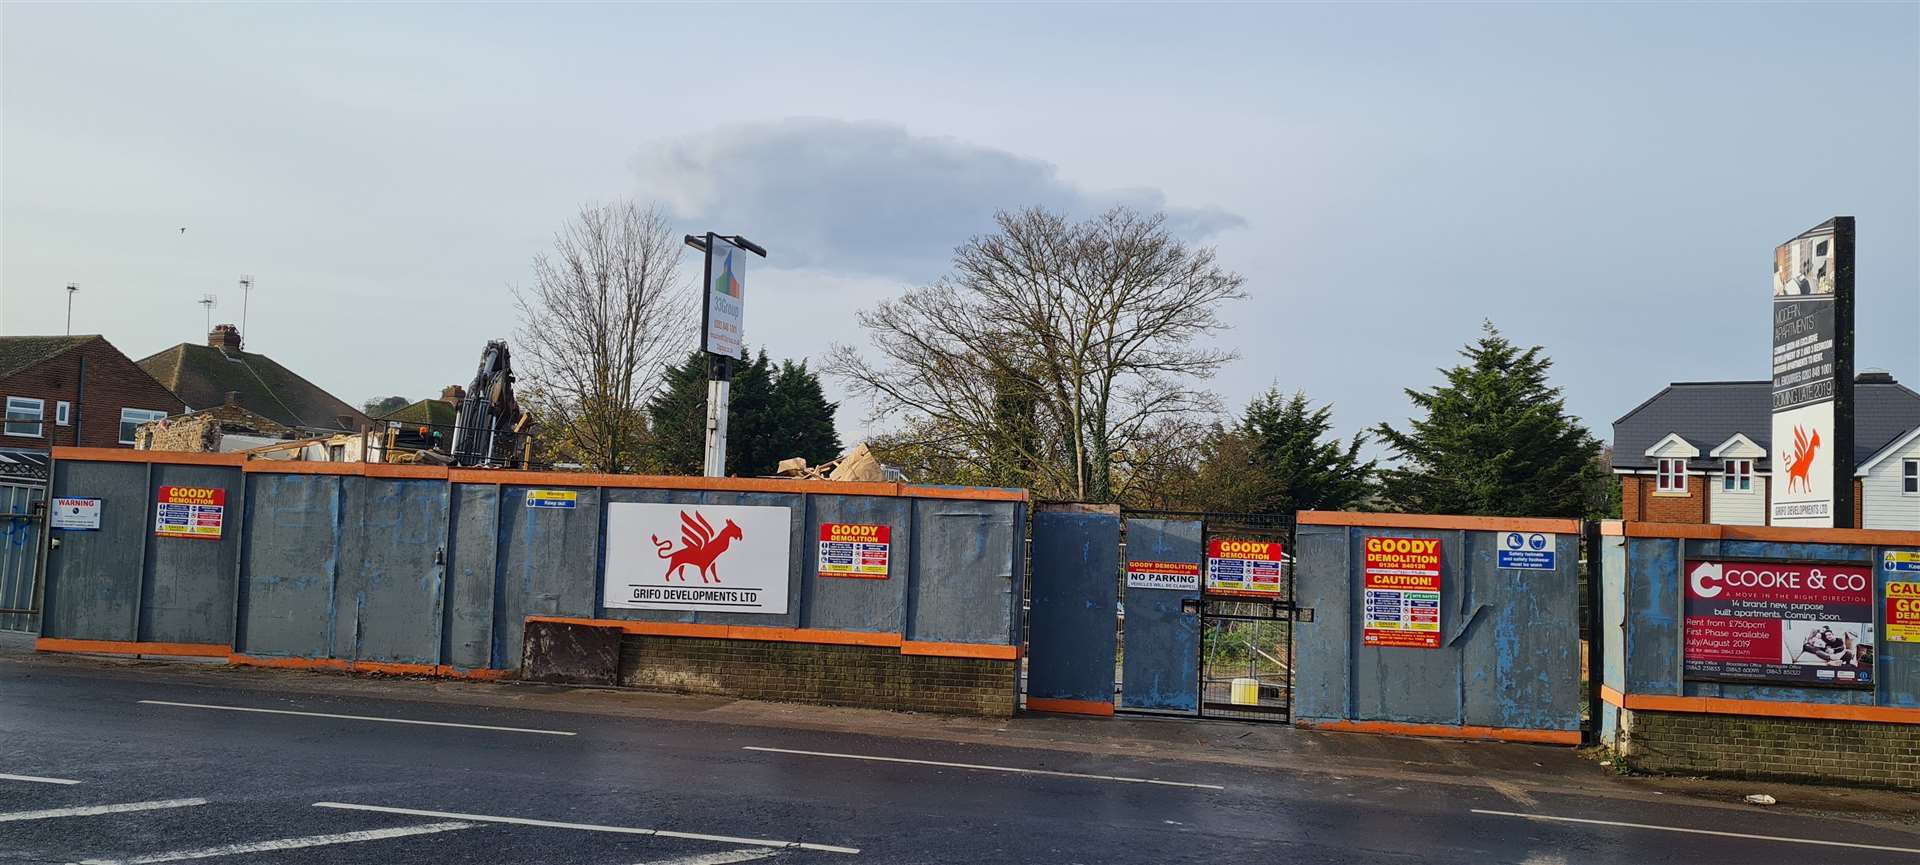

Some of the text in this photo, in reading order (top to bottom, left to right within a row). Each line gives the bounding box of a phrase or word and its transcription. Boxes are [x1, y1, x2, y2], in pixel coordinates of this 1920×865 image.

[1775, 304, 1800, 324] MODERN
[1775, 314, 1814, 340] APARTMENTS
[1781, 372, 1801, 386] ENQUIRIES
[1774, 381, 1832, 407] COMING LATE 2019
[170, 487, 214, 498] GOODY
[1788, 504, 1819, 515] DEVELOPMENTS
[831, 525, 878, 535] GOODY
[1221, 542, 1269, 553] GOODY
[1368, 539, 1439, 553] GOODY
[1368, 554, 1438, 563] DEMOLITION
[1149, 575, 1195, 583] PARKING
[1373, 575, 1432, 585] CAUTION!
[1726, 569, 1866, 591] COOKE & CO
[633, 589, 757, 602] GRIFO DEVELOPMENTS LTD
[1734, 610, 1781, 618] apartments.
[1785, 611, 1816, 620] Coming
[1686, 639, 1730, 647] July/August
